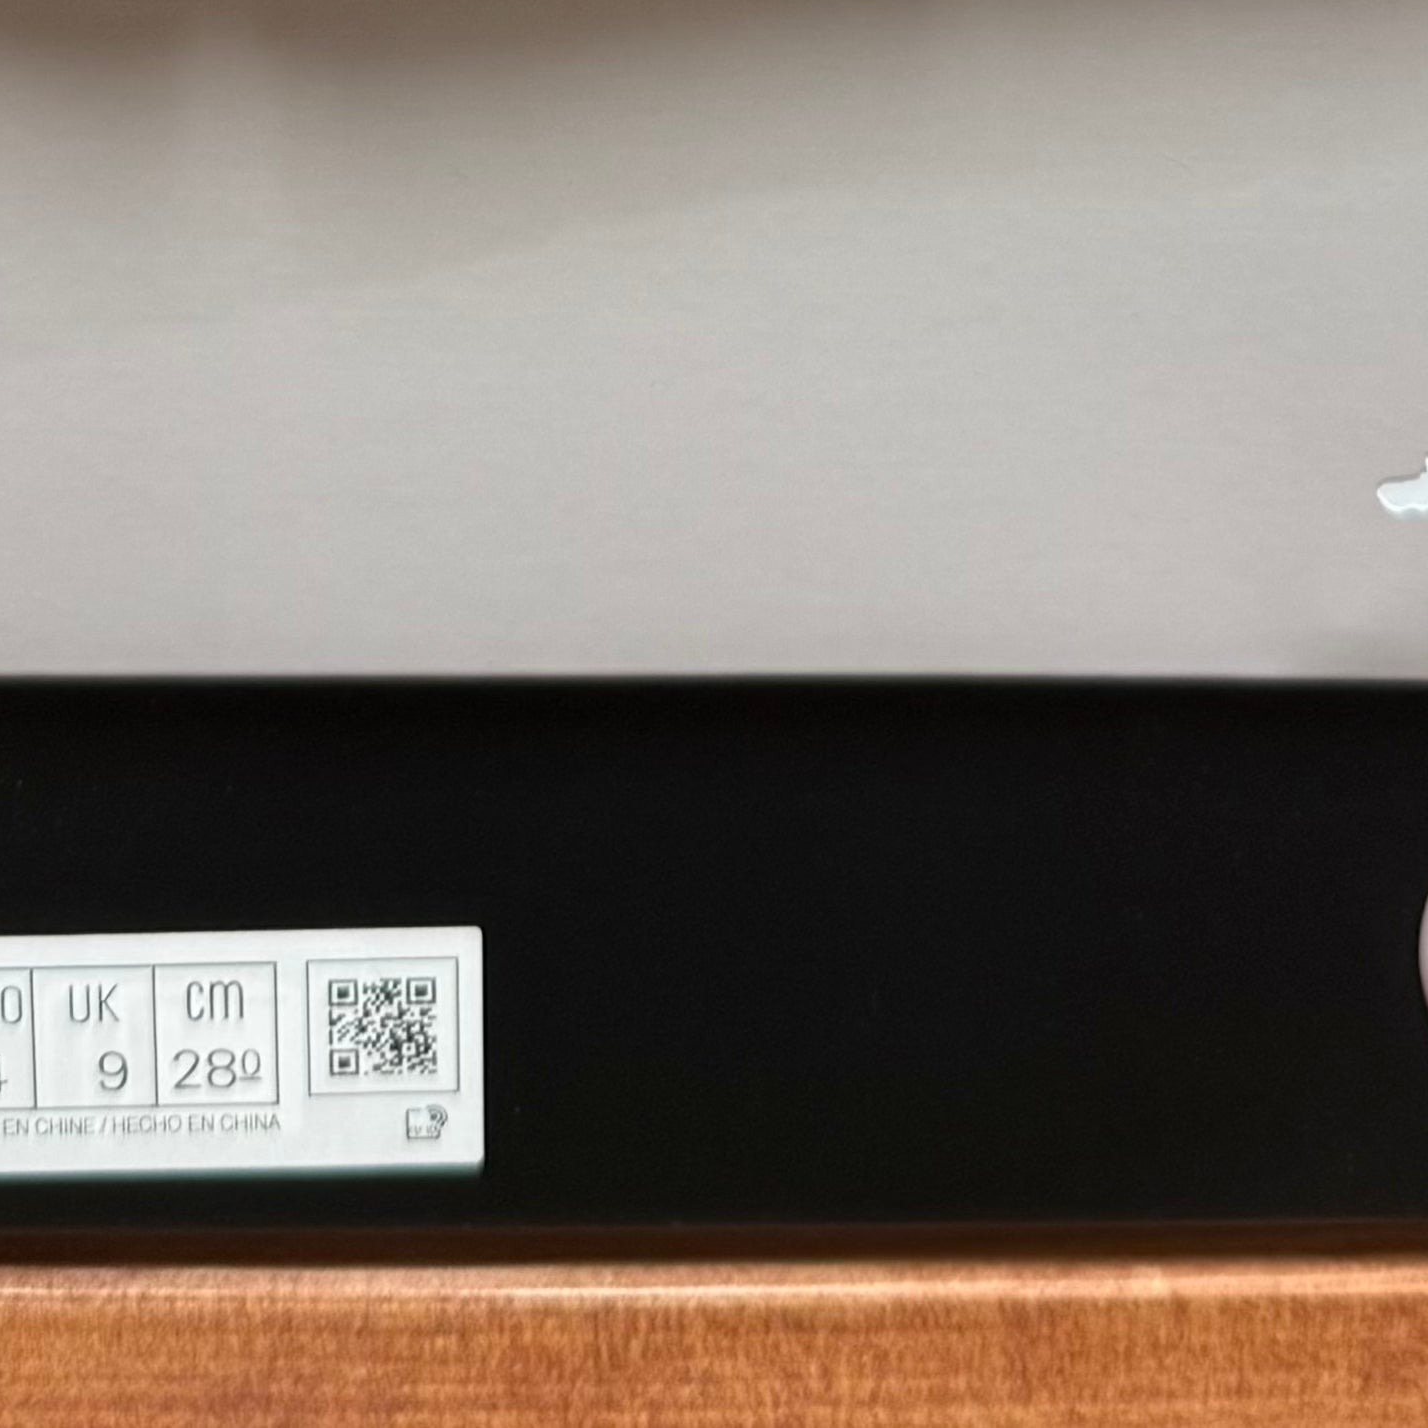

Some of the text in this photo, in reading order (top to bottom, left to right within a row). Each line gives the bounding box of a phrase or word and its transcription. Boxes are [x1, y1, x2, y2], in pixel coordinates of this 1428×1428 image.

[68, 982, 120, 1023] UK
[97, 1049, 128, 1091] 9
[2, 1117, 29, 1137] EN
[35, 1115, 95, 1136] CHINE
[112, 1114, 182, 1135] HECHO
[188, 1114, 215, 1133] EN
[220, 1112, 282, 1133] CHINA
